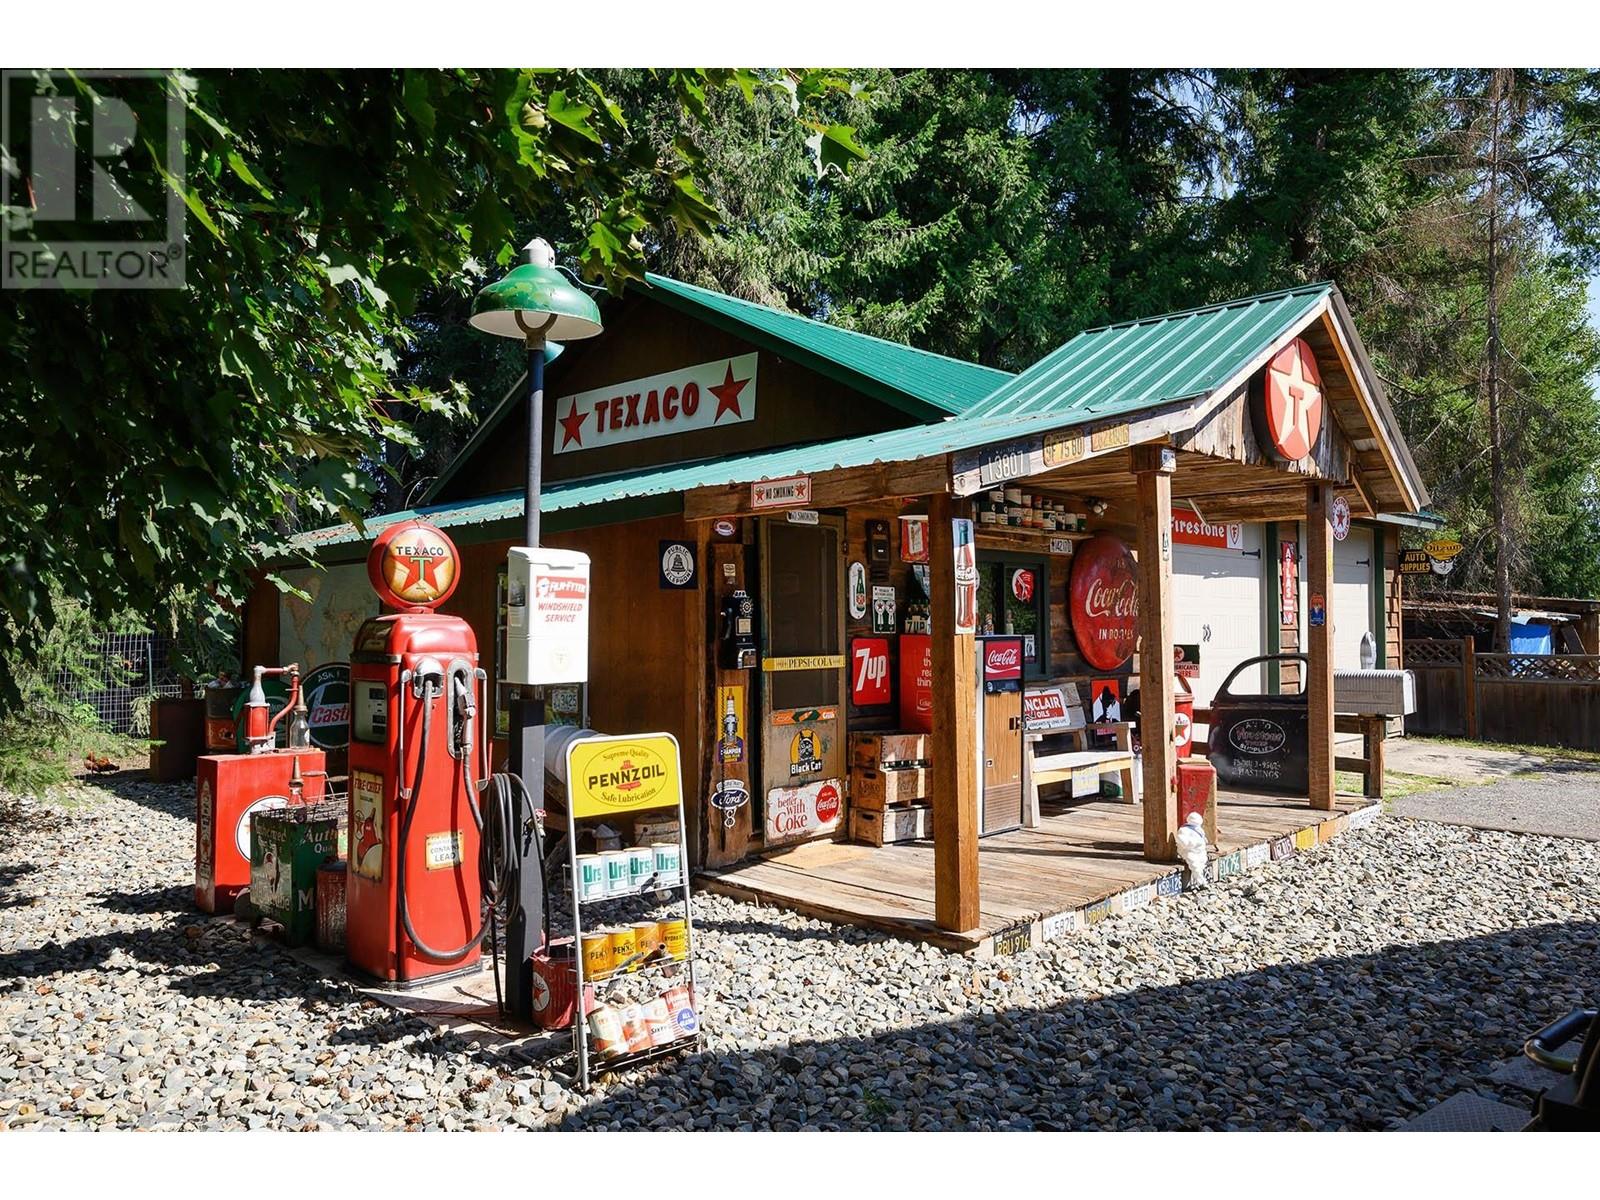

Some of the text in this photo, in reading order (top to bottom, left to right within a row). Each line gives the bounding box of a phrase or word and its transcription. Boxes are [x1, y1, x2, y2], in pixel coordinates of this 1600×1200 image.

[594, 381, 700, 433] TEXACO
[766, 485, 794, 499] NO SMOKING
[396, 546, 444, 556] TEXACO
[667, 545, 689, 556] PUBLIC
[1405, 553, 1426, 562] AUTO
[1400, 562, 1430, 571] SUPPLIES
[664, 568, 692, 583] TELEPHONE
[538, 602, 583, 611] WINDSHIELD
[545, 614, 576, 622] SERVICE
[987, 649, 1018, 667] Coca-Cola
[917, 677, 932, 688] thin
[1025, 696, 1062, 712] NCLAIR
[602, 747, 650, 761] Supreme Quality
[791, 760, 822, 775] Black Cat
[588, 764, 665, 790] PENNZOIL
[601, 787, 656, 803] Safe Lubrication
[786, 800, 806, 816] with
[775, 812, 808, 833] Coke
[434, 851, 457, 863] LEAD
